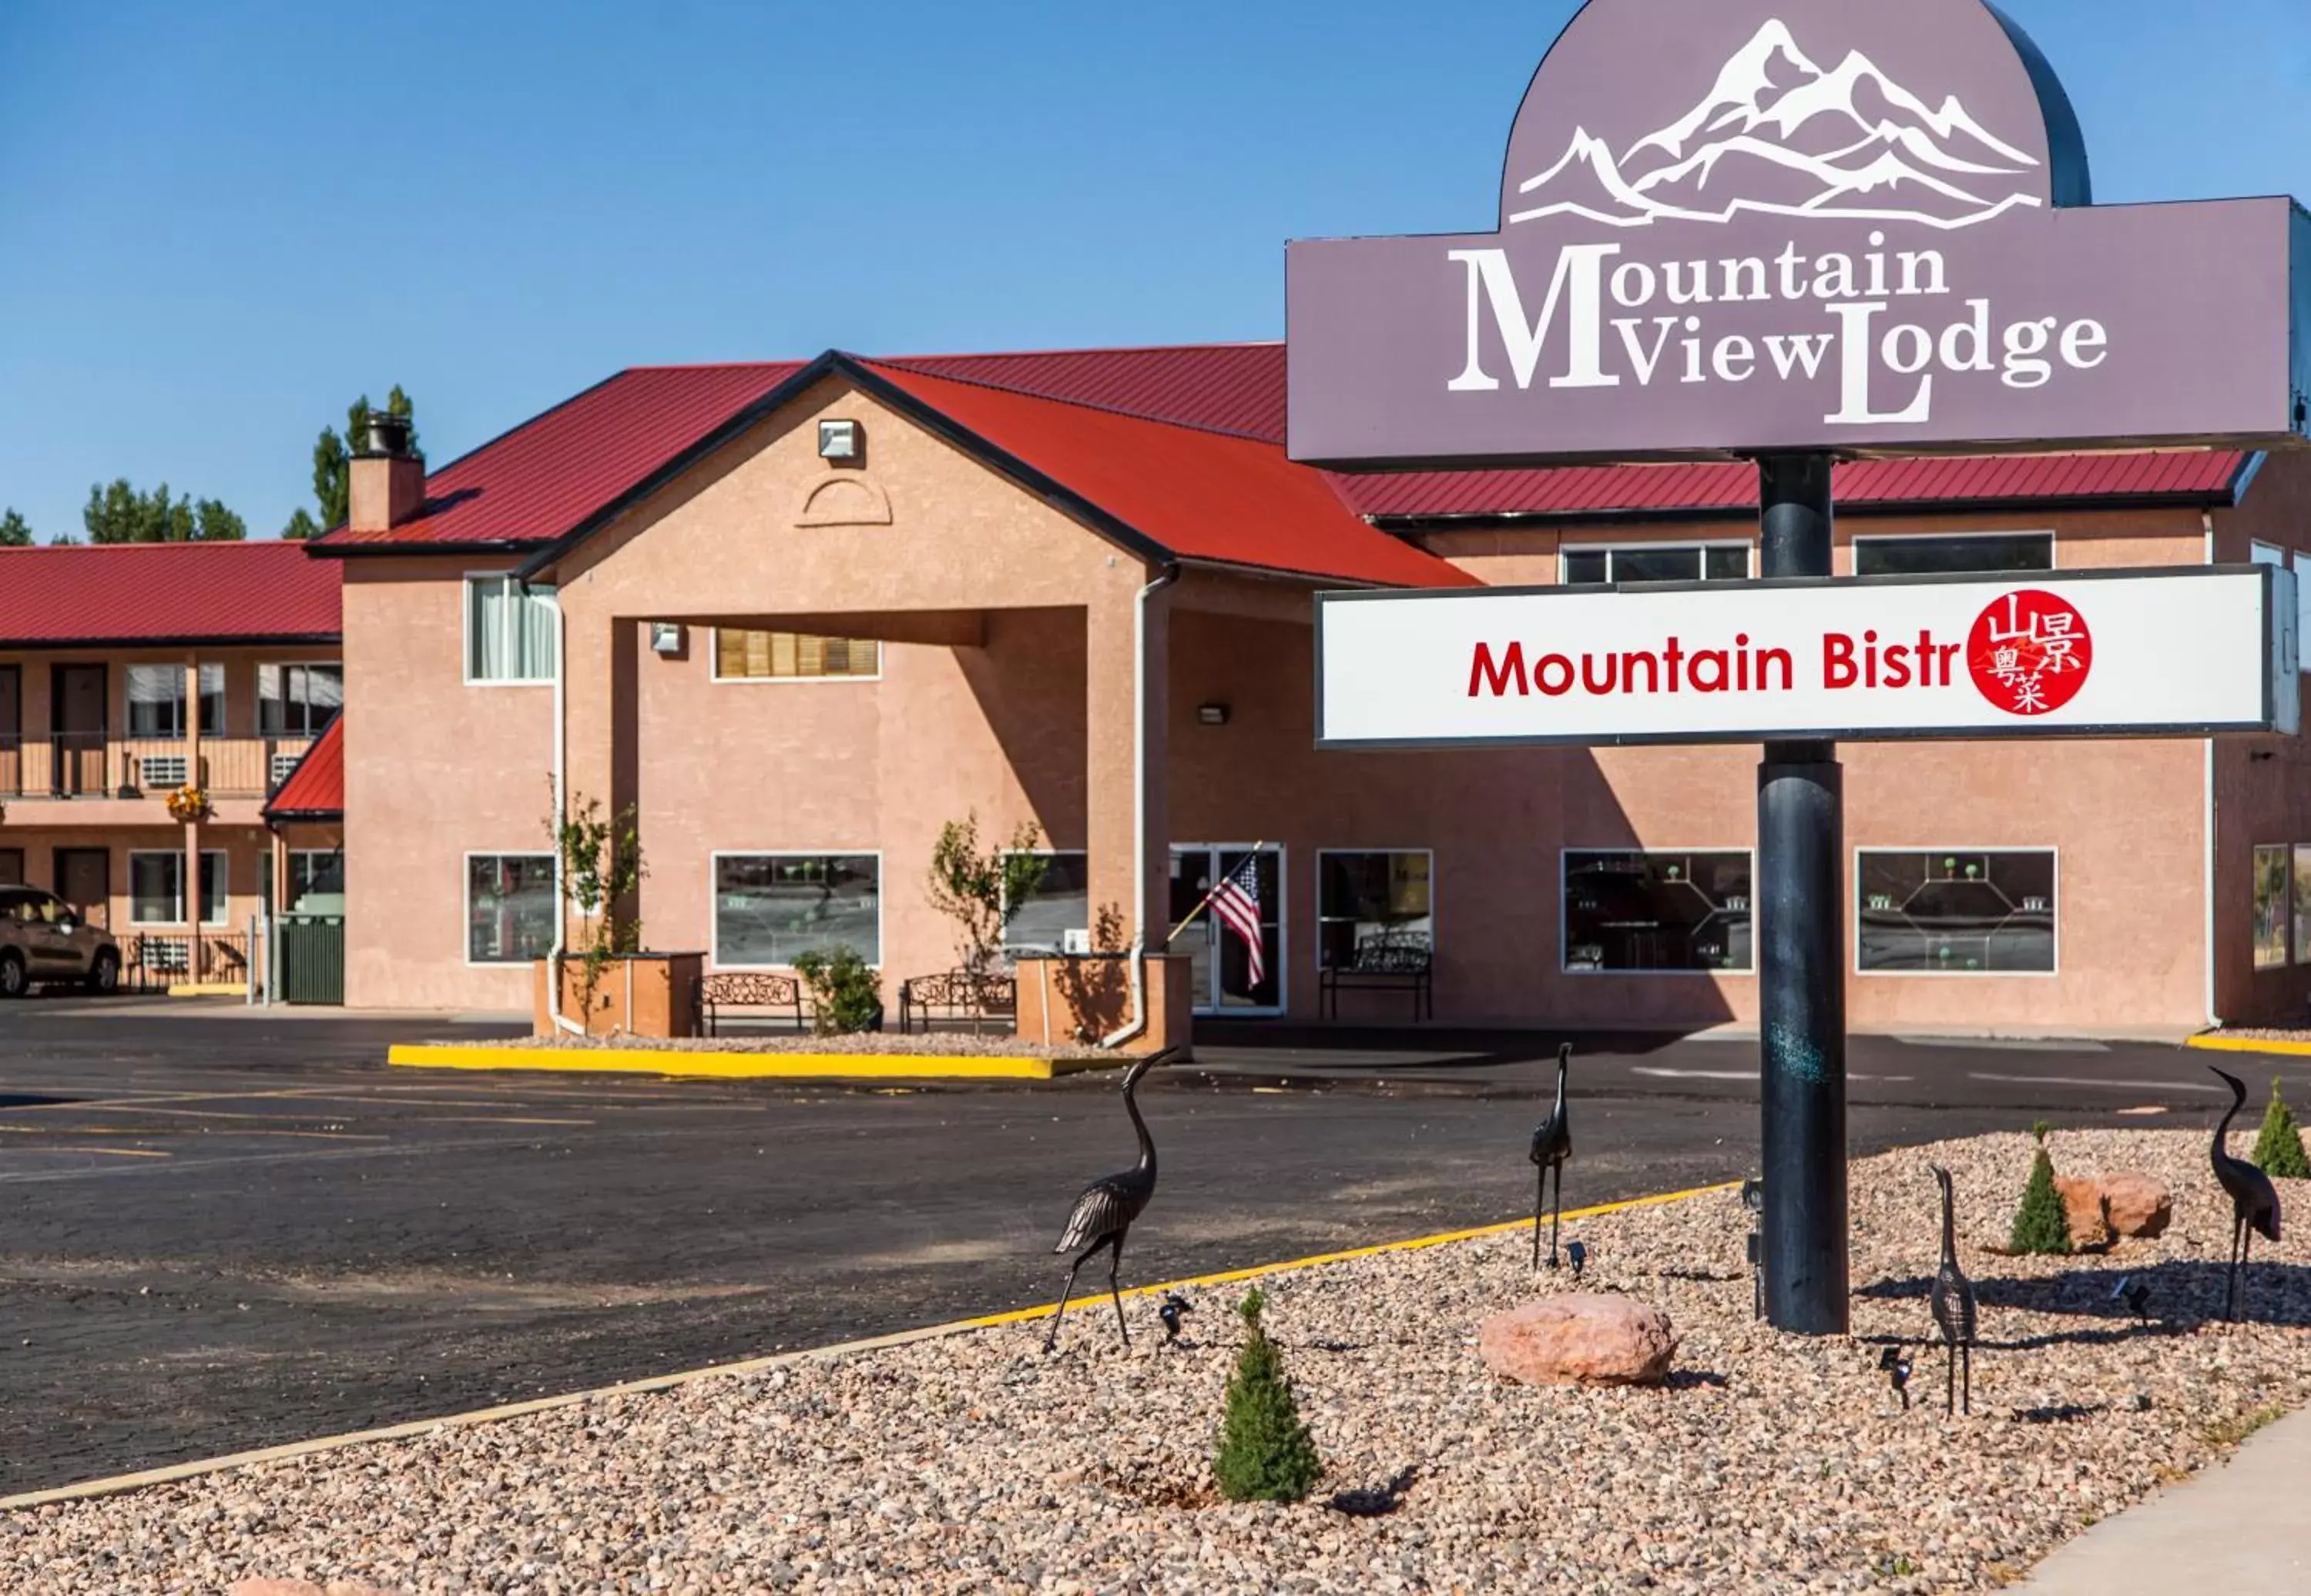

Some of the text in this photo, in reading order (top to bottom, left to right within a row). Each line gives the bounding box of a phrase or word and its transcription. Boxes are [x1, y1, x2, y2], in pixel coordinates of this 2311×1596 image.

[1447, 230, 1950, 392] Mountain
[1609, 298, 2108, 424] View Lodge
[1468, 632, 1794, 697] Mountain
